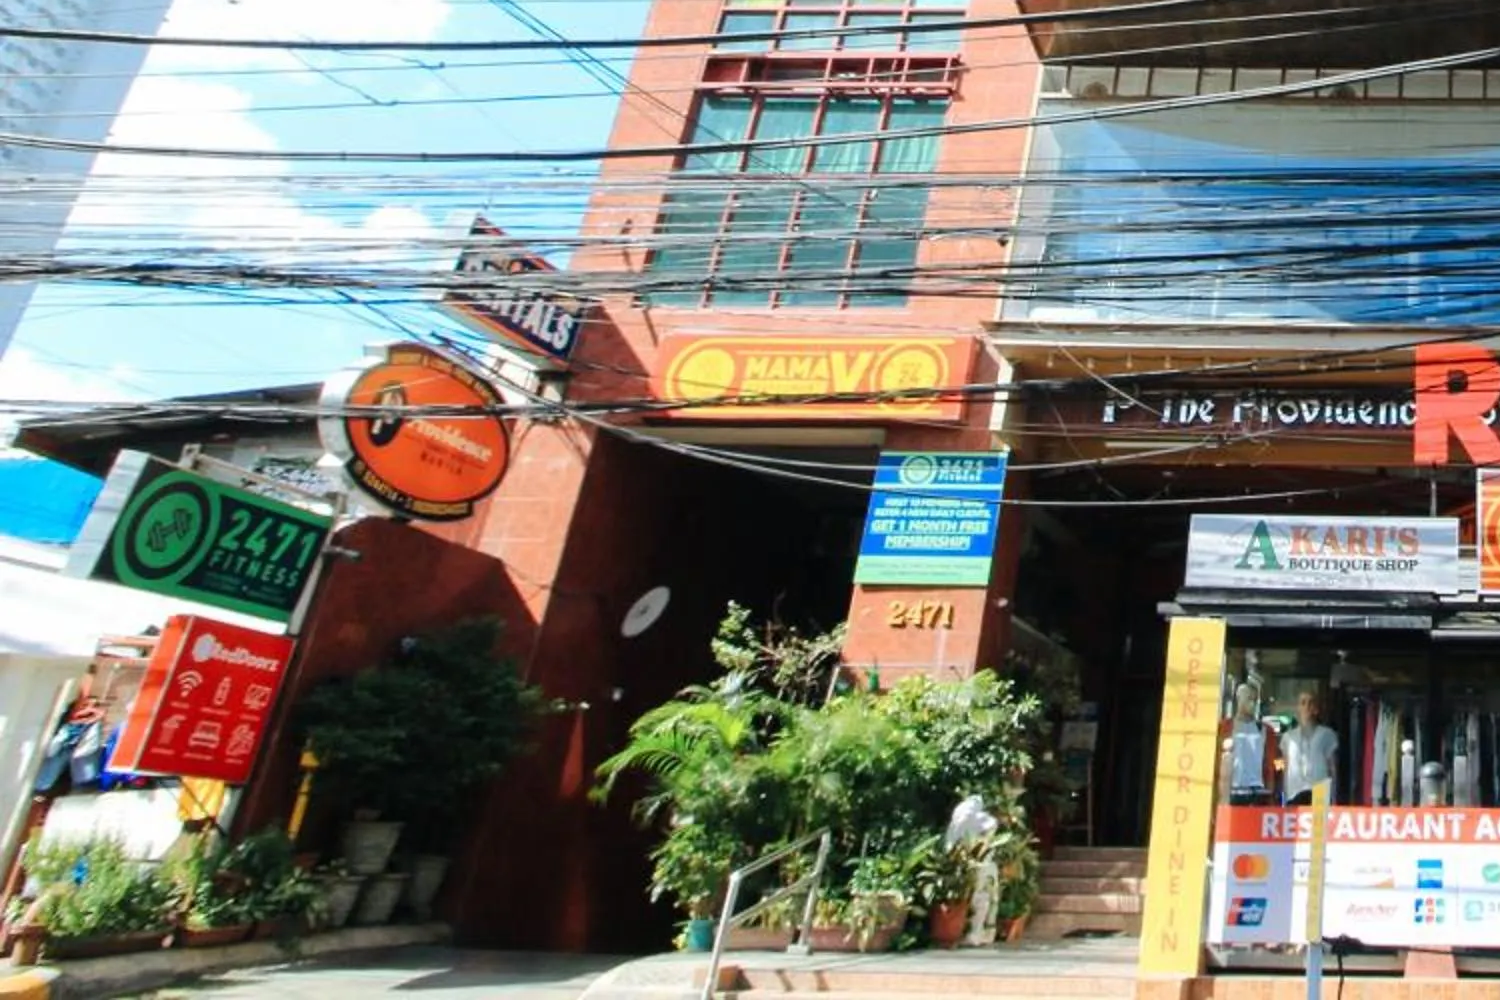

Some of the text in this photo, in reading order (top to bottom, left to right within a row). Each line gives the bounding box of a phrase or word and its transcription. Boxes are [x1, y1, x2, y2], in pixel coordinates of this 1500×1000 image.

[744, 354, 829, 379] MAMA
[1232, 391, 1415, 425] Providenc
[218, 508, 318, 569] 2471
[870, 519, 897, 535] GET
[908, 519, 957, 535] MONTH
[958, 519, 989, 535] FREE
[1288, 524, 1420, 557] KARI'S
[208, 550, 299, 588] FITNESS
[1288, 558, 1419, 573] BOUTIQUE SHOP
[887, 600, 957, 630] 2471
[1160, 638, 1203, 952] OPEN FOR DINE IN
[1261, 812, 1465, 840] RESAURANT
